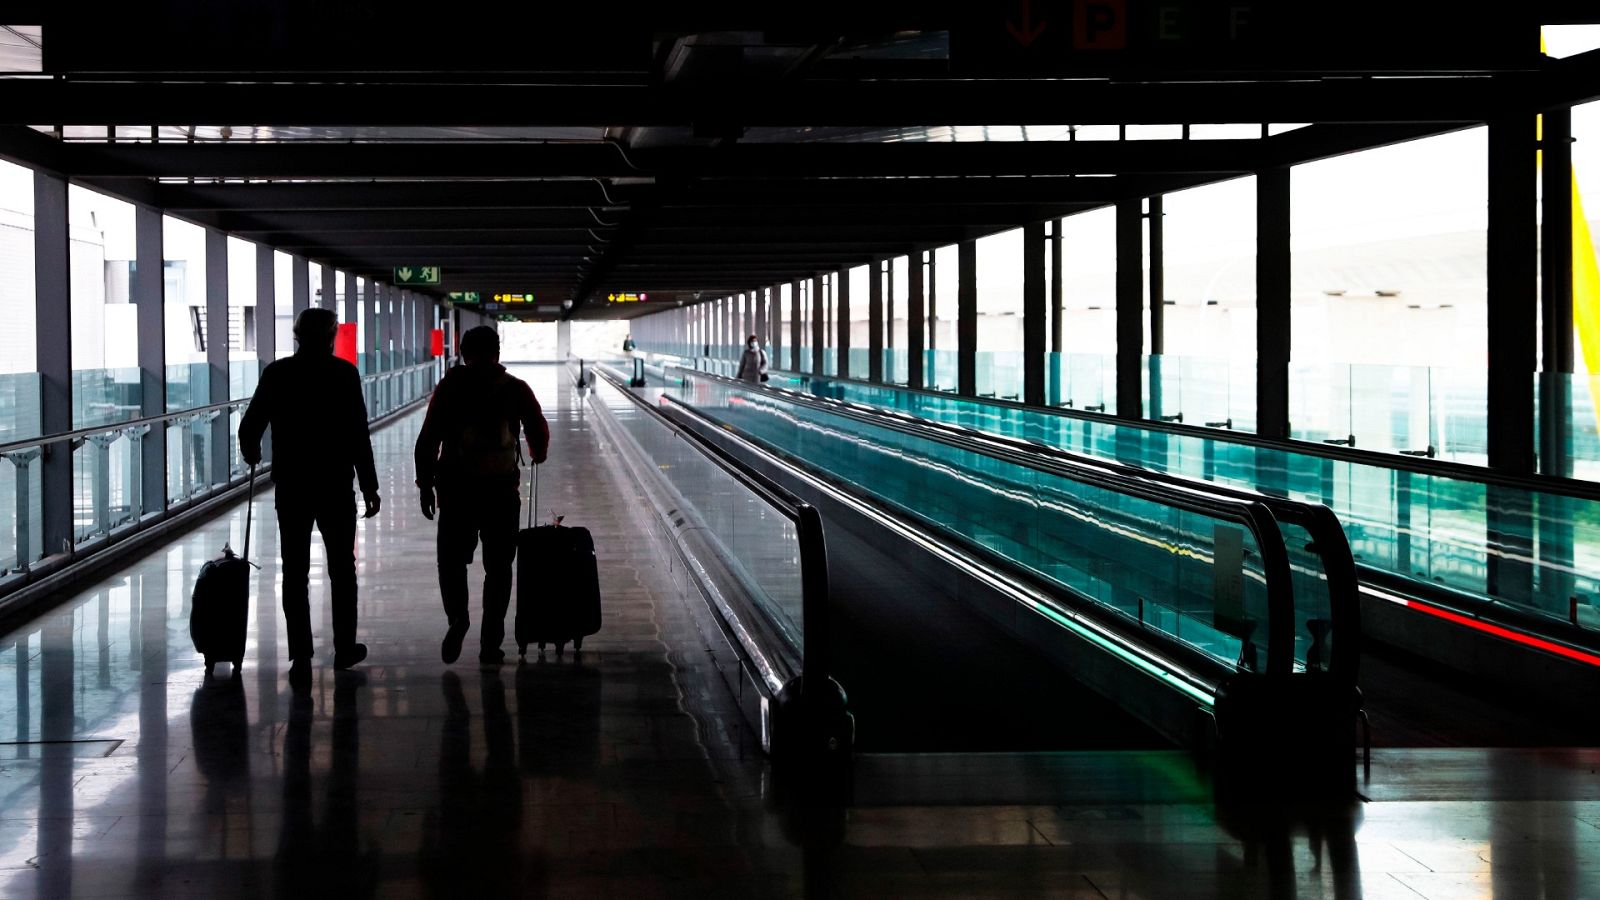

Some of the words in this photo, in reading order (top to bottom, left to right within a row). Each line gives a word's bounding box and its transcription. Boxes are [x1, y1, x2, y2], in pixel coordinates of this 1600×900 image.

[1088, 5, 1115, 43] P
[1159, 6, 1181, 40] E
[1230, 7, 1250, 40] F
